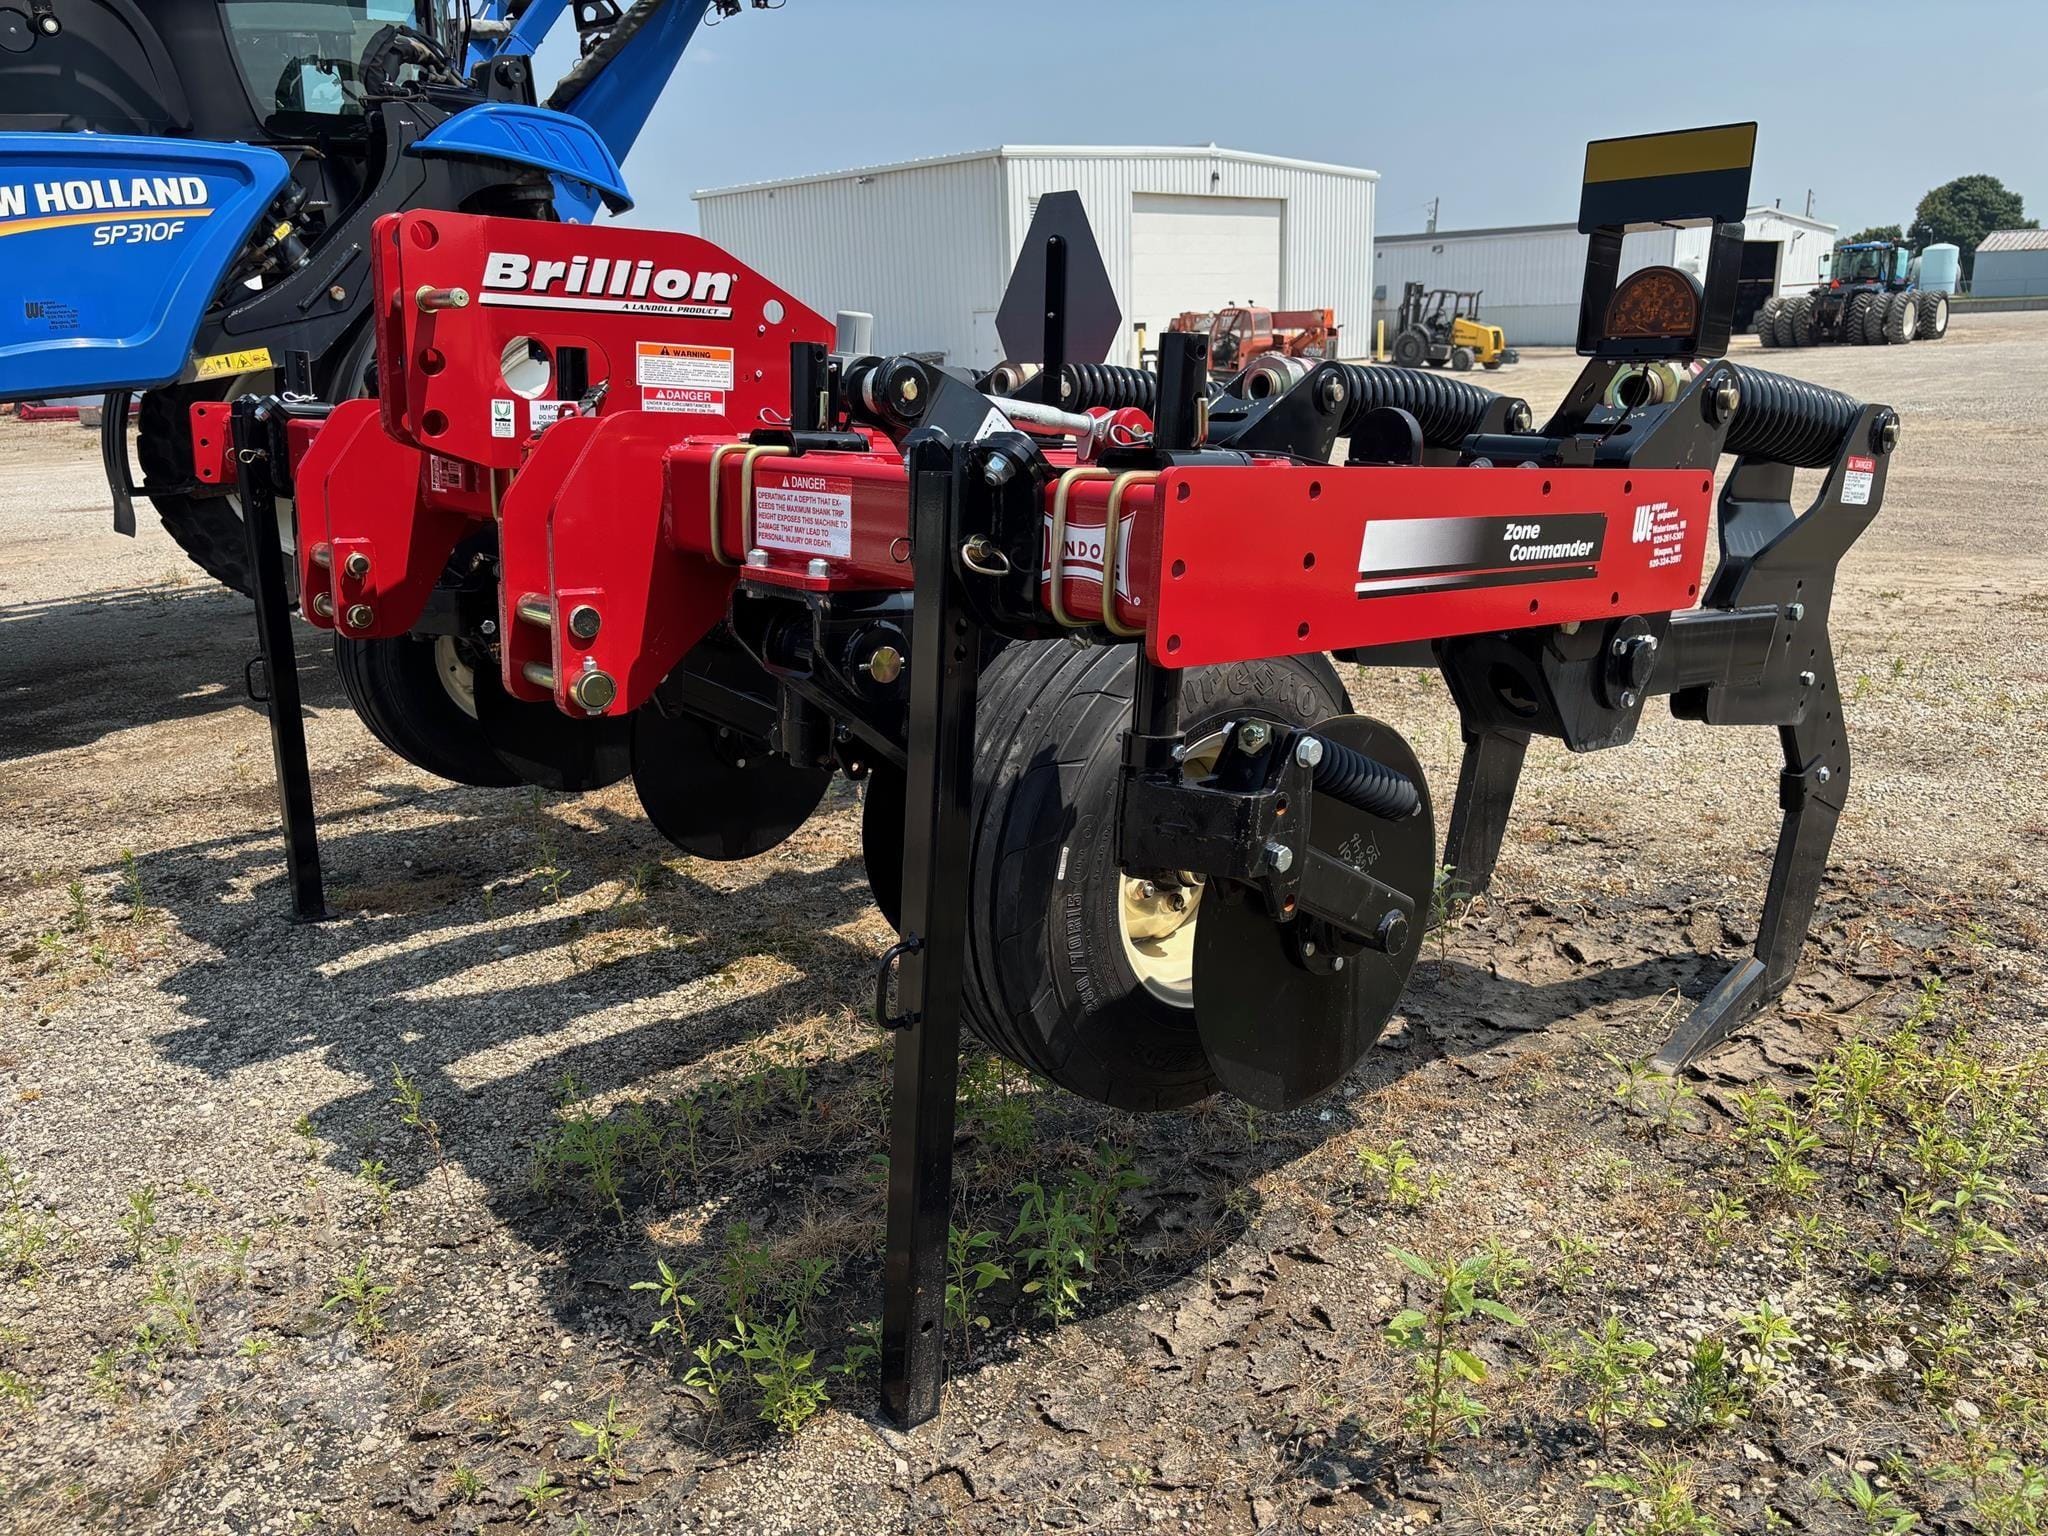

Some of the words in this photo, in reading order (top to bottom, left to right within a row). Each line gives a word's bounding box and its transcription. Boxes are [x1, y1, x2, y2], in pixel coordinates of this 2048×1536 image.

[34, 177, 208, 213] HOLLAND
[93, 221, 185, 246] SP310F
[482, 252, 732, 302] Brillion
[632, 304, 674, 313] LANDOLL
[677, 306, 719, 315] PRODUCT
[673, 350, 711, 359] WARNING
[666, 390, 712, 401] DANGER
[791, 476, 826, 490] DANGER
[758, 491, 786, 501] OPERATING
[787, 494, 794, 502] AT
[799, 495, 817, 505] DEPTH
[817, 497, 831, 506] THAT
[832, 498, 841, 506] EX-
[758, 502, 775, 511] CEEDS
[776, 503, 786, 512] THE
[787, 505, 811, 515] MAXIMUM
[812, 507, 831, 517] SHANK
[832, 509, 844, 518] TRIP
[758, 511, 776, 520] HEIGHT
[778, 513, 801, 524] EXPOSES
[802, 516, 814, 525] THIS
[815, 518, 839, 528] MACHINE
[840, 520, 848, 529] TO
[758, 521, 780, 531] DAMAGE
[781, 524, 793, 533] THAT
[794, 526, 805, 534] MAY
[806, 527, 820, 536] LEAD
[821, 529, 829, 537] TO
[1504, 523, 1541, 540] Zone
[758, 531, 785, 543] PERSONAL
[786, 535, 804, 545] INJURY
[804, 537, 812, 546] OR
[814, 538, 831, 548] DEATH
[1509, 540, 1594, 562] Commander
